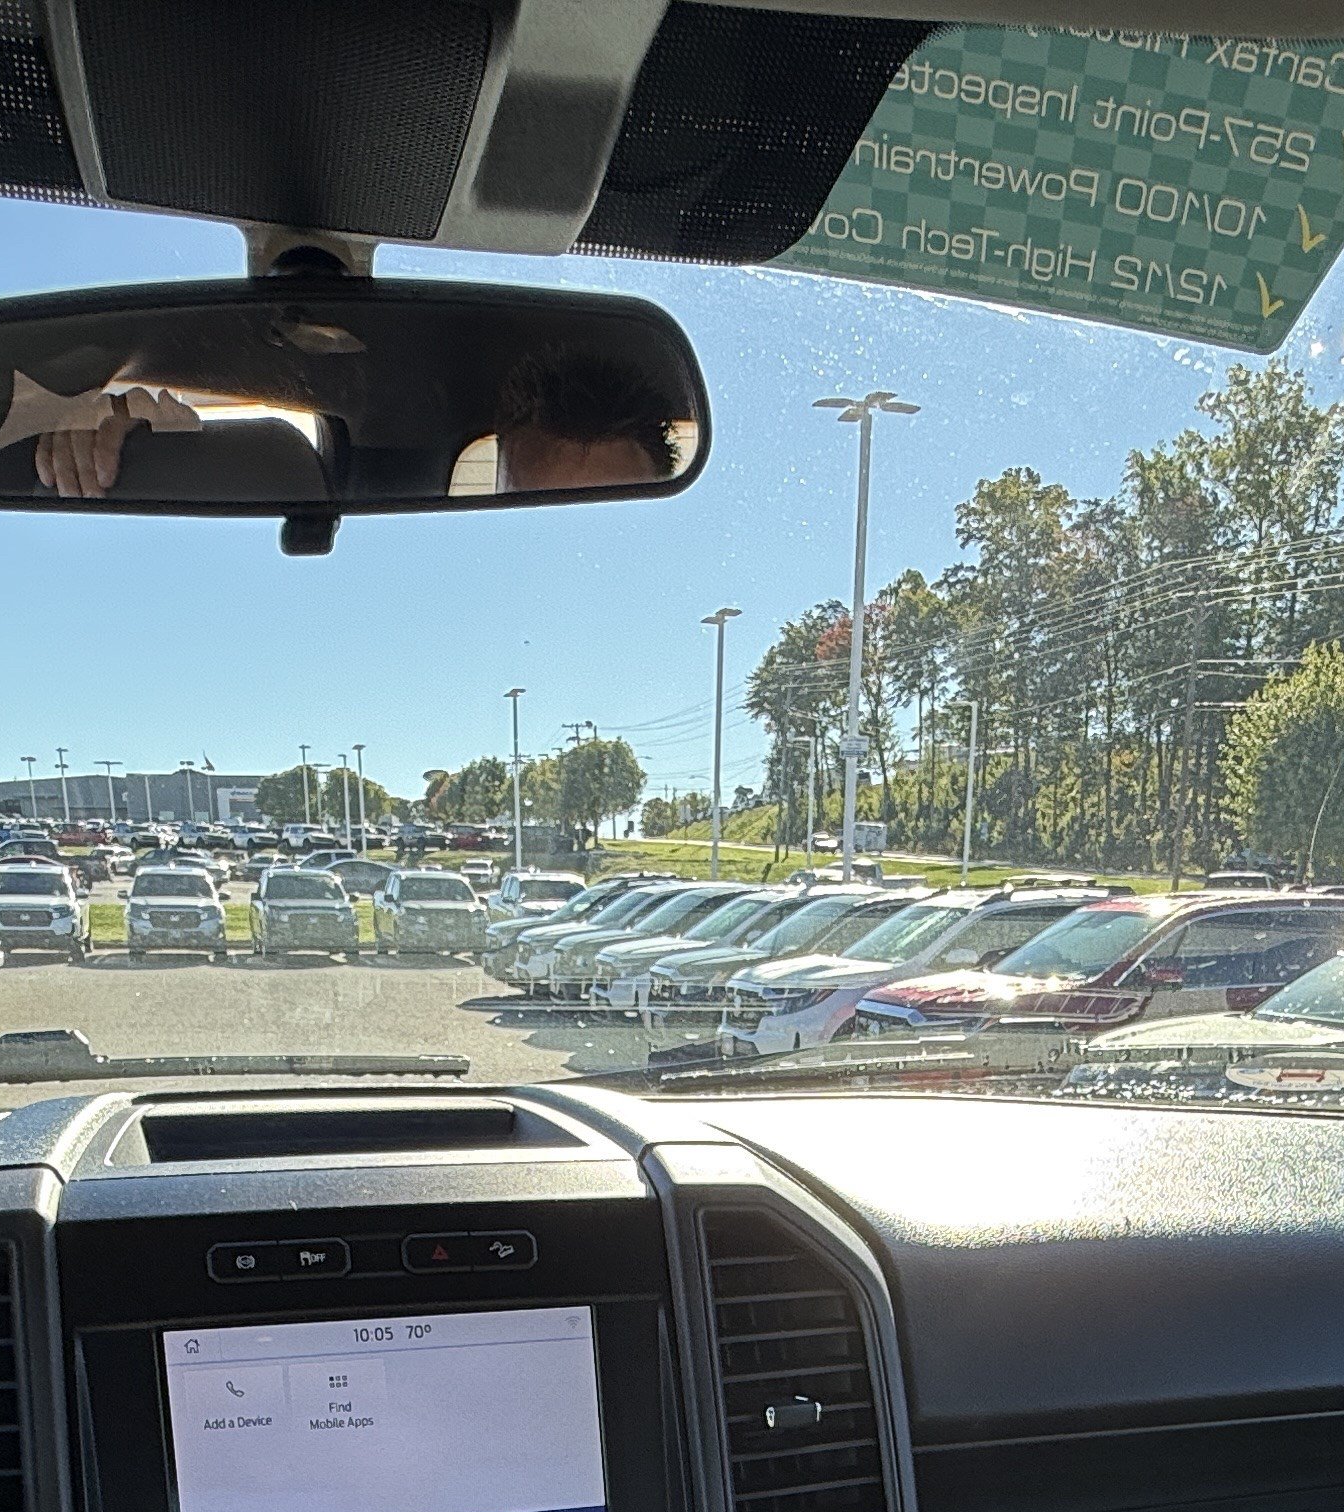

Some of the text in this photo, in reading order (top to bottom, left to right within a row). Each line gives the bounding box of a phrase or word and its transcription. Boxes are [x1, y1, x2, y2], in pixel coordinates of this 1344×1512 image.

[311, 1251, 326, 1262] OFF
[353, 1326, 394, 1343] 10:05
[329, 1402, 352, 1413] Find
[204, 1415, 273, 1430] Add a Device
[309, 1416, 374, 1430] Mobile Apps
